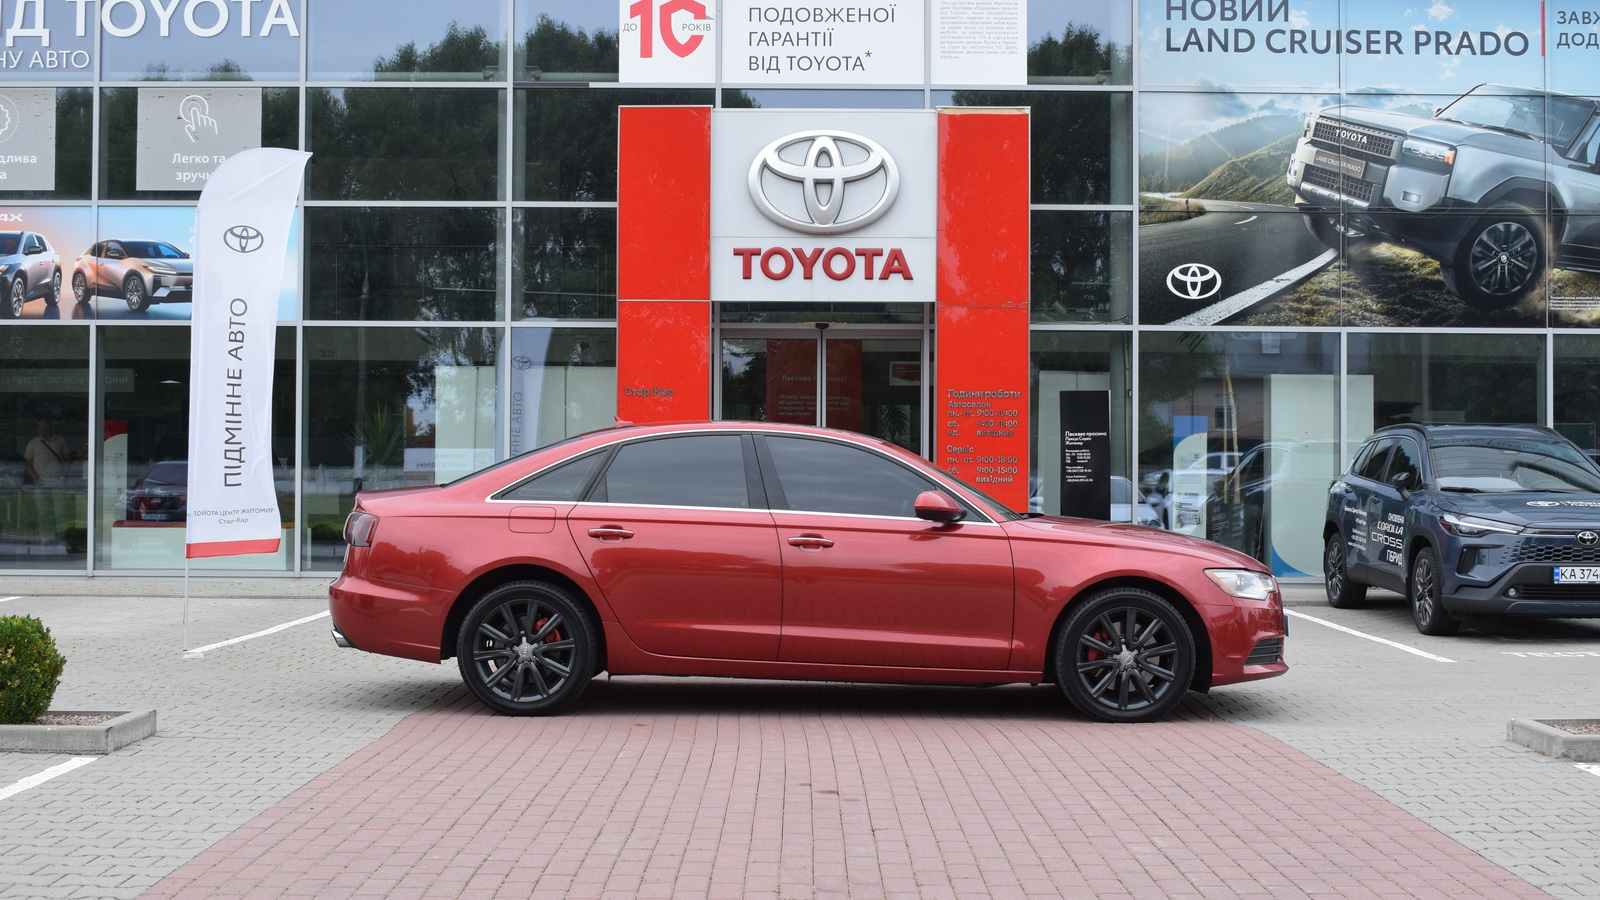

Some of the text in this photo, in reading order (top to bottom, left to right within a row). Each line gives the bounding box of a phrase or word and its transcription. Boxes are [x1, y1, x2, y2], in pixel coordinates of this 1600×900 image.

[66, 0, 300, 38] TOYOTA
[749, 4, 895, 25] ПОДОВЖЕНОЇ
[623, 23, 638, 32] ДО
[682, 23, 712, 31] РОКІВ
[749, 28, 834, 46] ГАРАНТІЇ
[1166, 28, 1530, 56] LAND CRUISER PRADO
[29, 50, 90, 68] АВТО
[749, 56, 781, 74] ВІД
[1335, 129, 1367, 144] TOYOTA
[172, 153, 226, 164] Легко та
[733, 247, 914, 281] TOYOTA
[224, 298, 248, 488] ПІДМІННЕ АВТО
[624, 386, 674, 398] Стар-Кар
[948, 389, 1021, 400] Години роботи
[947, 445, 974, 454] Сервіс
[976, 475, 1014, 483] вихідний
[1377, 520, 1404, 536] COROLLA
[1371, 532, 1402, 549] CROSS
[1560, 569, 1576, 579] KA
